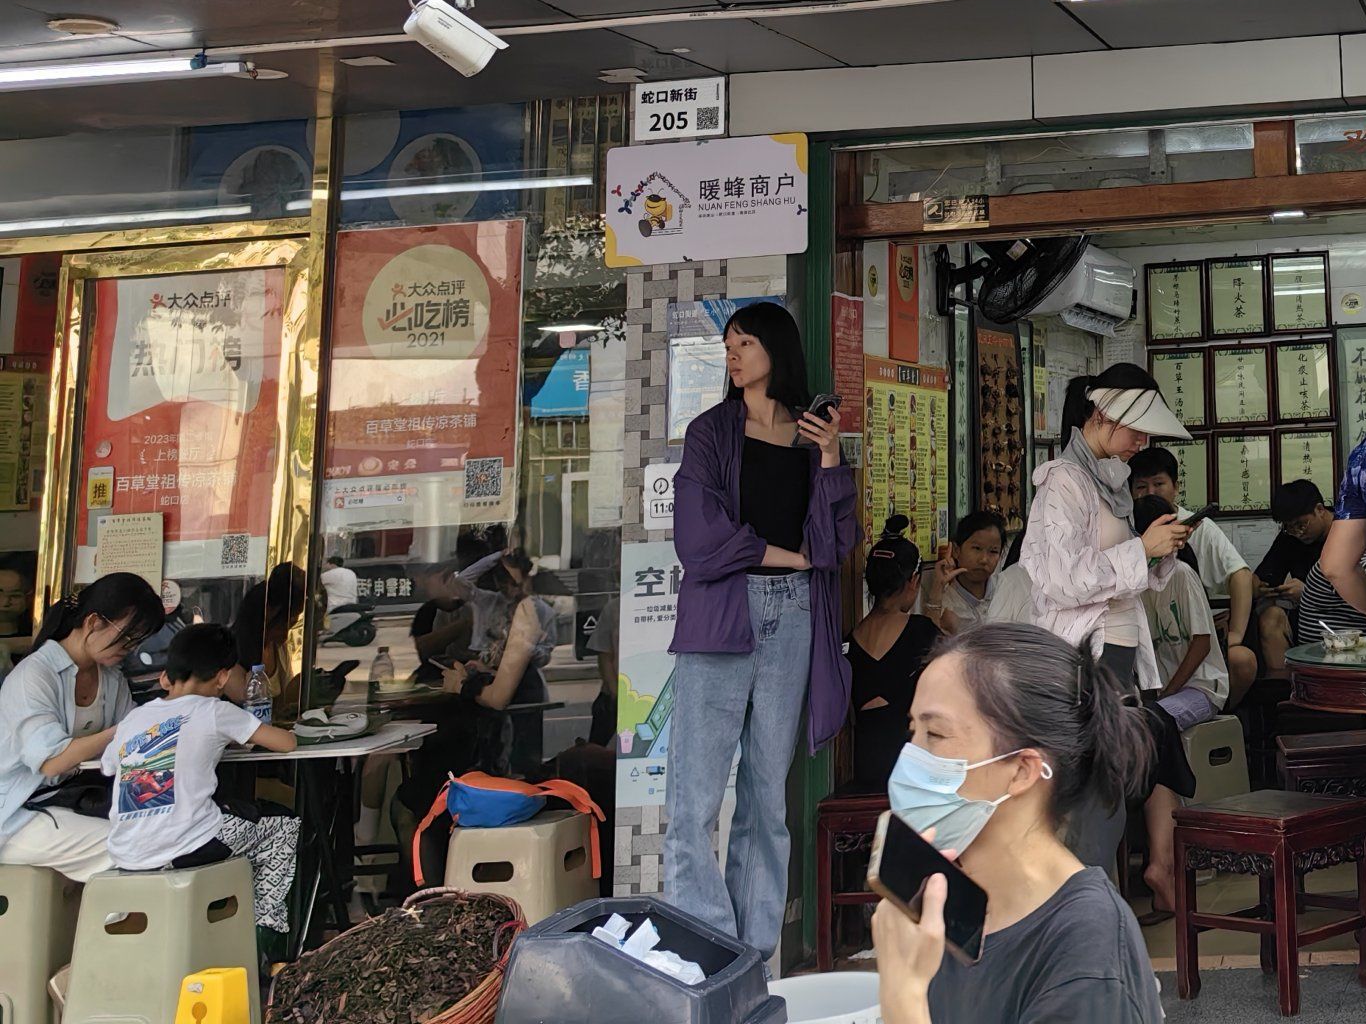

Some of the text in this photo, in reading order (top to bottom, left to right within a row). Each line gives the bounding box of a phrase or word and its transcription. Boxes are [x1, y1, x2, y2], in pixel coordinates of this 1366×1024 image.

[641, 87, 698, 105] 蛇口新街
[649, 111, 688, 132] 205
[699, 173, 794, 200] 暖蜂商户
[698, 195, 796, 211] NUAN FENG SHANG HU
[407, 279, 465, 298] 大众点评
[1232, 277, 1246, 318] 降火茶
[167, 290, 231, 310] 大众点评
[377, 298, 470, 332] 必吃榜
[407, 332, 445, 348] 2021
[366, 414, 477, 434] 百草堂祖传凉茶铺
[1302, 441, 1313, 483] 清热祛
[92, 482, 107, 499] 推
